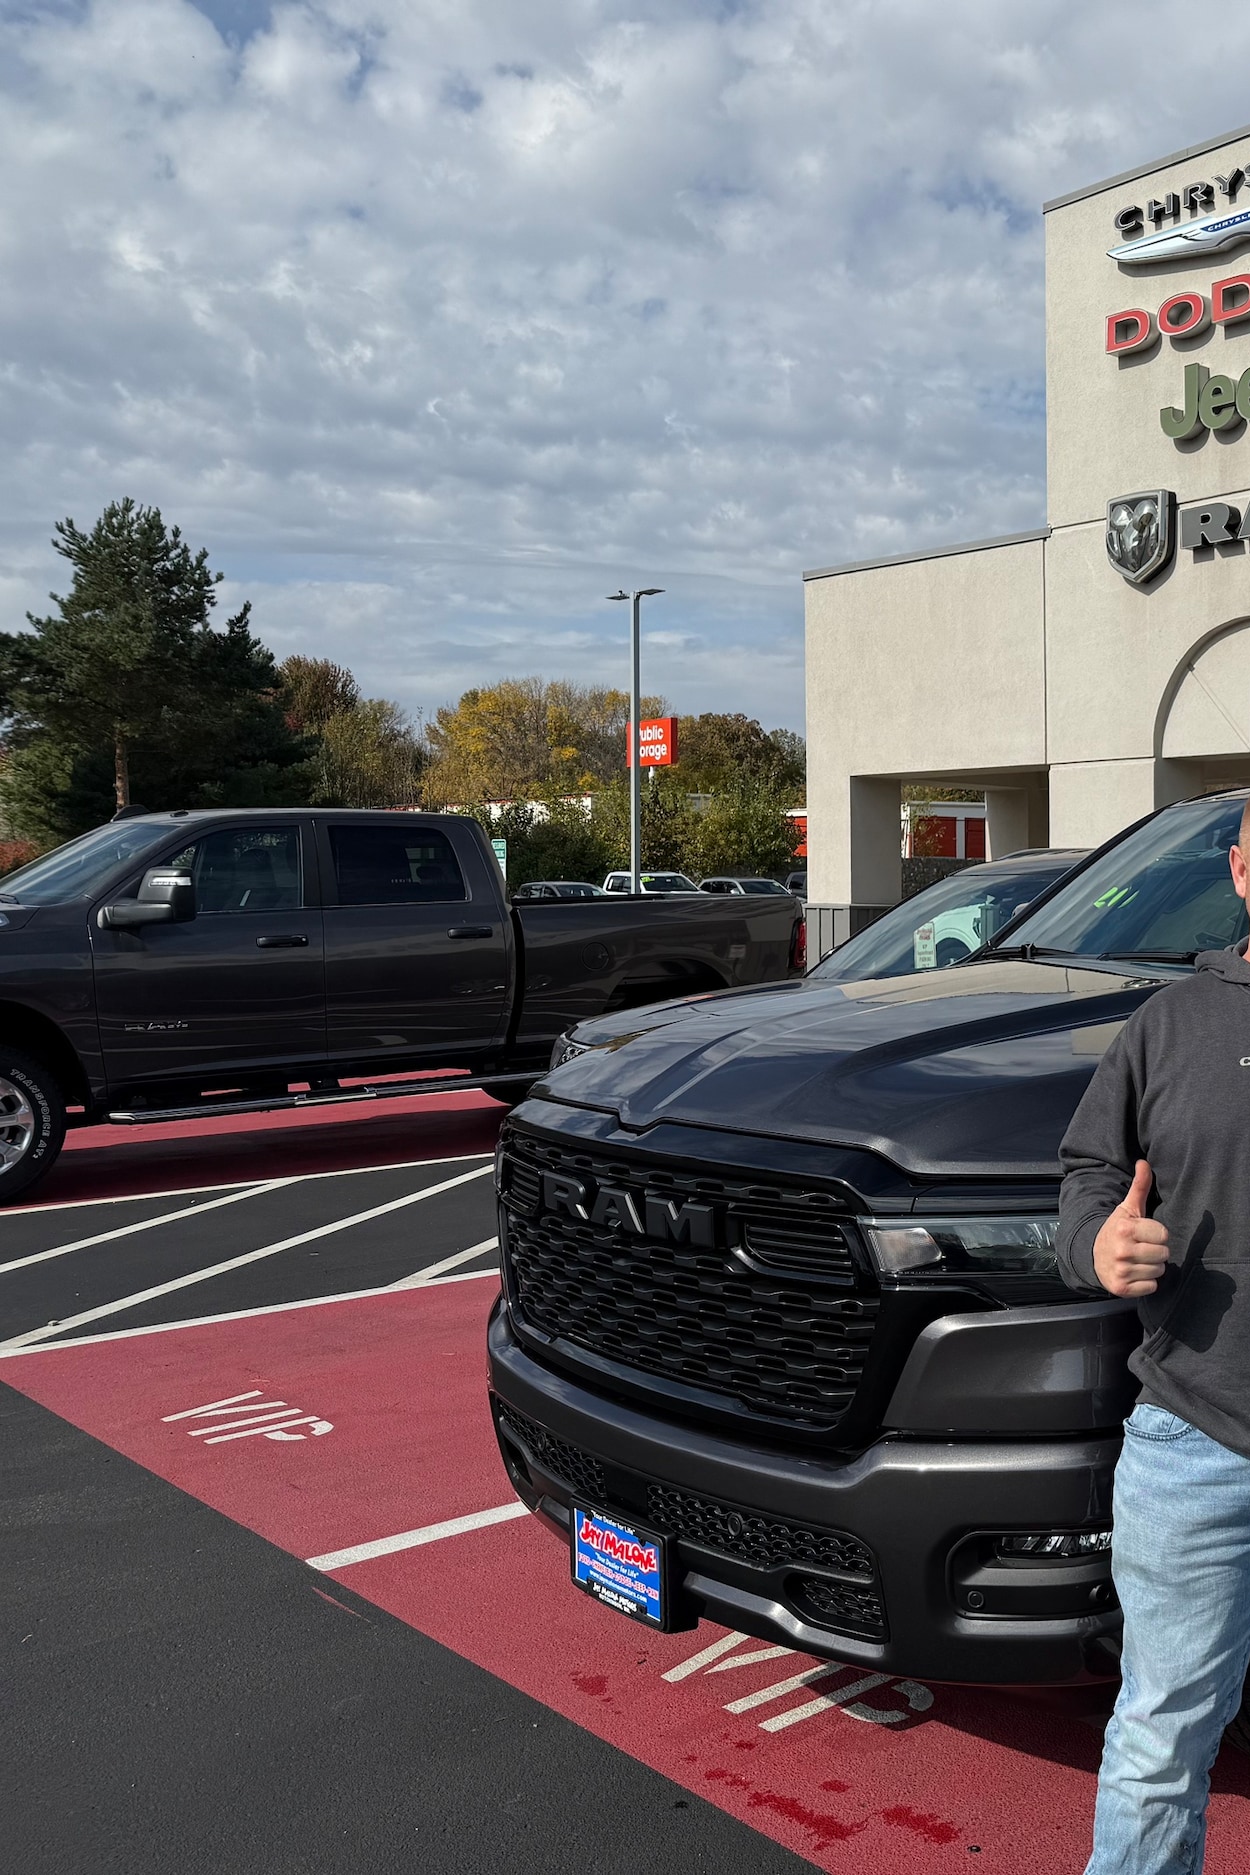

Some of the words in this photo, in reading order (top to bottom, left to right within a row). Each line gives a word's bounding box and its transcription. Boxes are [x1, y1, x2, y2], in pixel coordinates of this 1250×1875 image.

[639, 725, 664, 742] ublic
[639, 743, 667, 760] orage
[541, 1170, 715, 1249] RAM
[160, 1390, 334, 1445] VIP
[579, 1518, 603, 1550] JAY
[602, 1530, 659, 1574] MALONE
[660, 1631, 934, 1734] VIP
